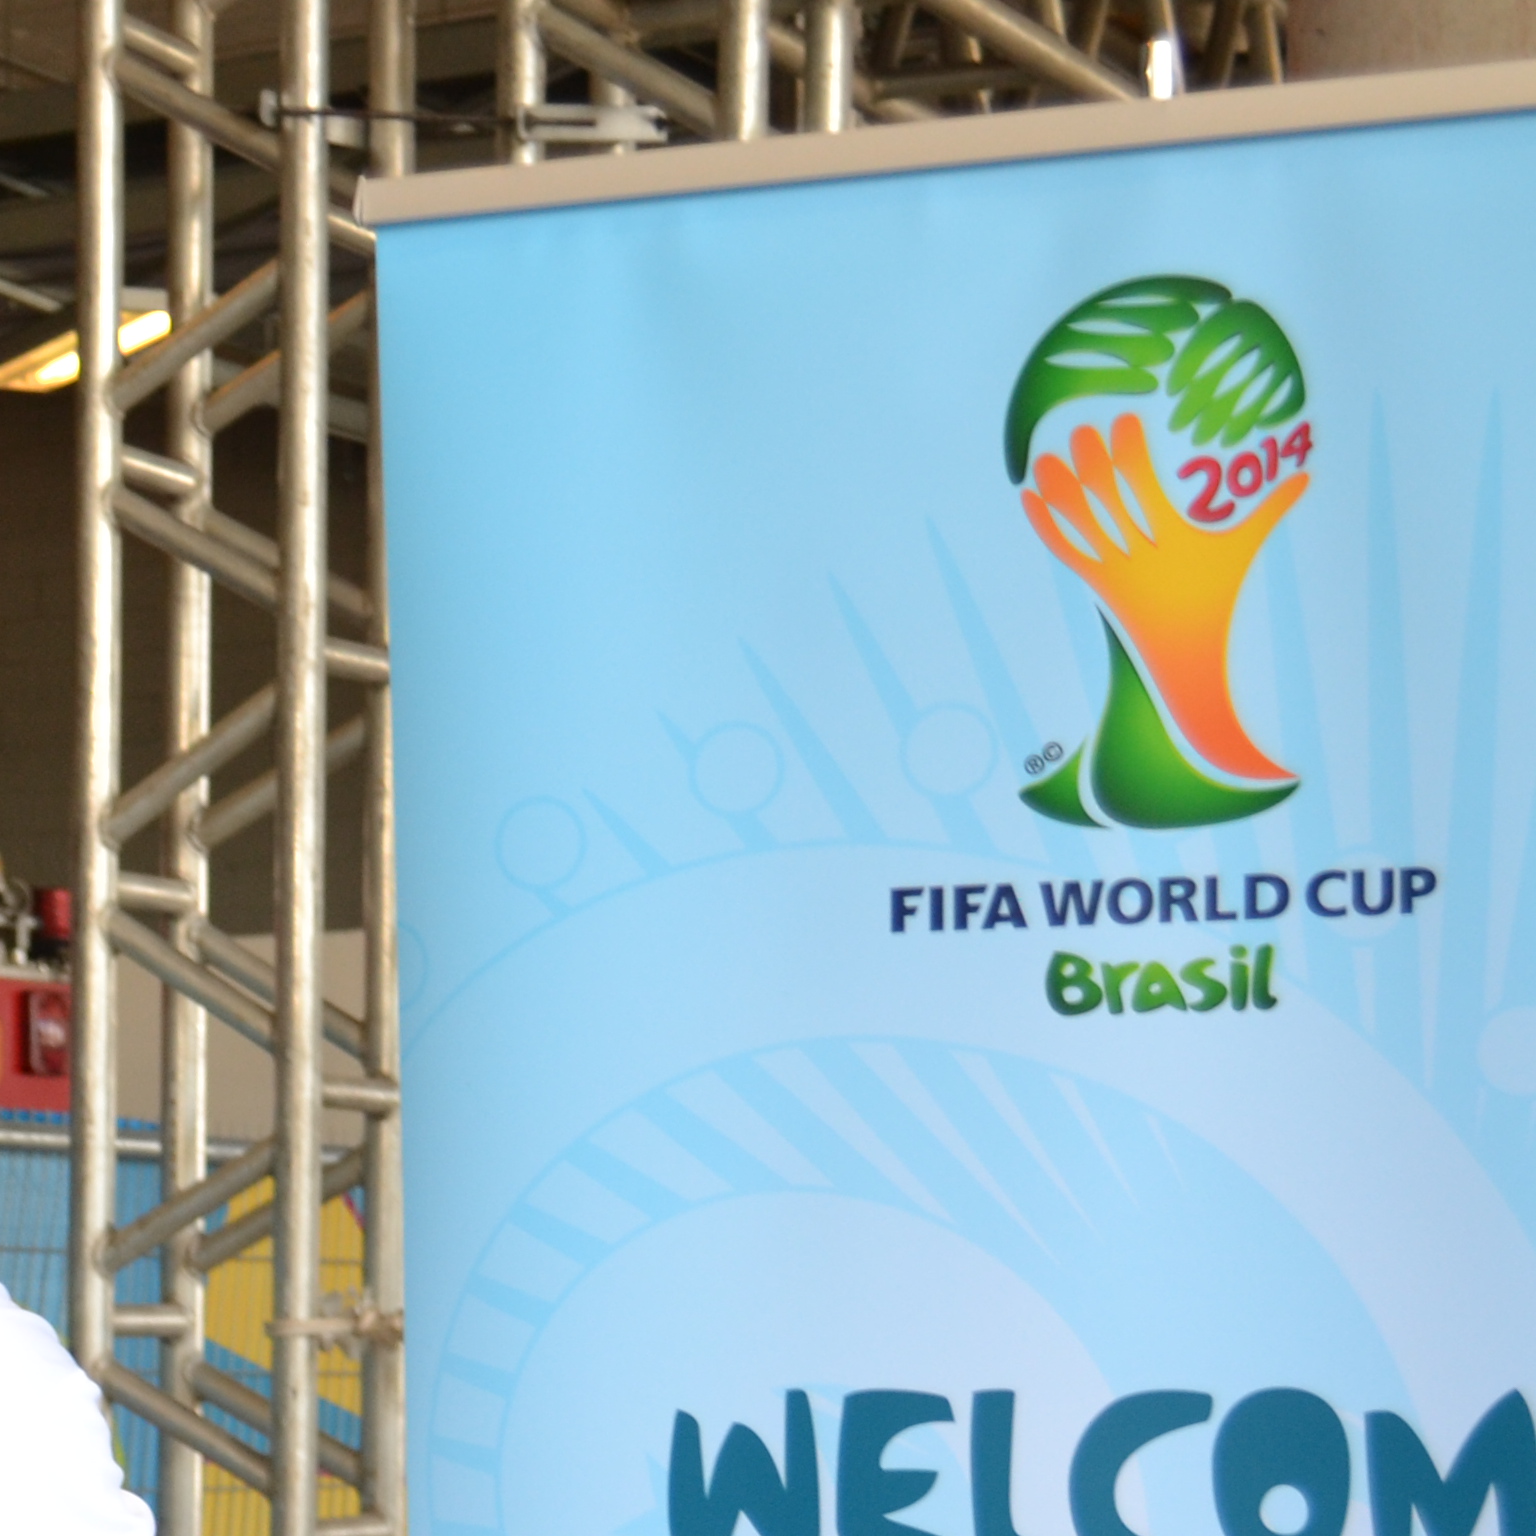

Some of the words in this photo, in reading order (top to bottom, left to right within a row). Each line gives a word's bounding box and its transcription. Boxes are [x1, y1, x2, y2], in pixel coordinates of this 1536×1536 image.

[1176, 421, 1315, 524] 2014
[888, 882, 1028, 934] FIFA
[1039, 874, 1291, 928] WORLD
[1304, 866, 1438, 917] CUP
[1045, 943, 1280, 1017] Brasil
